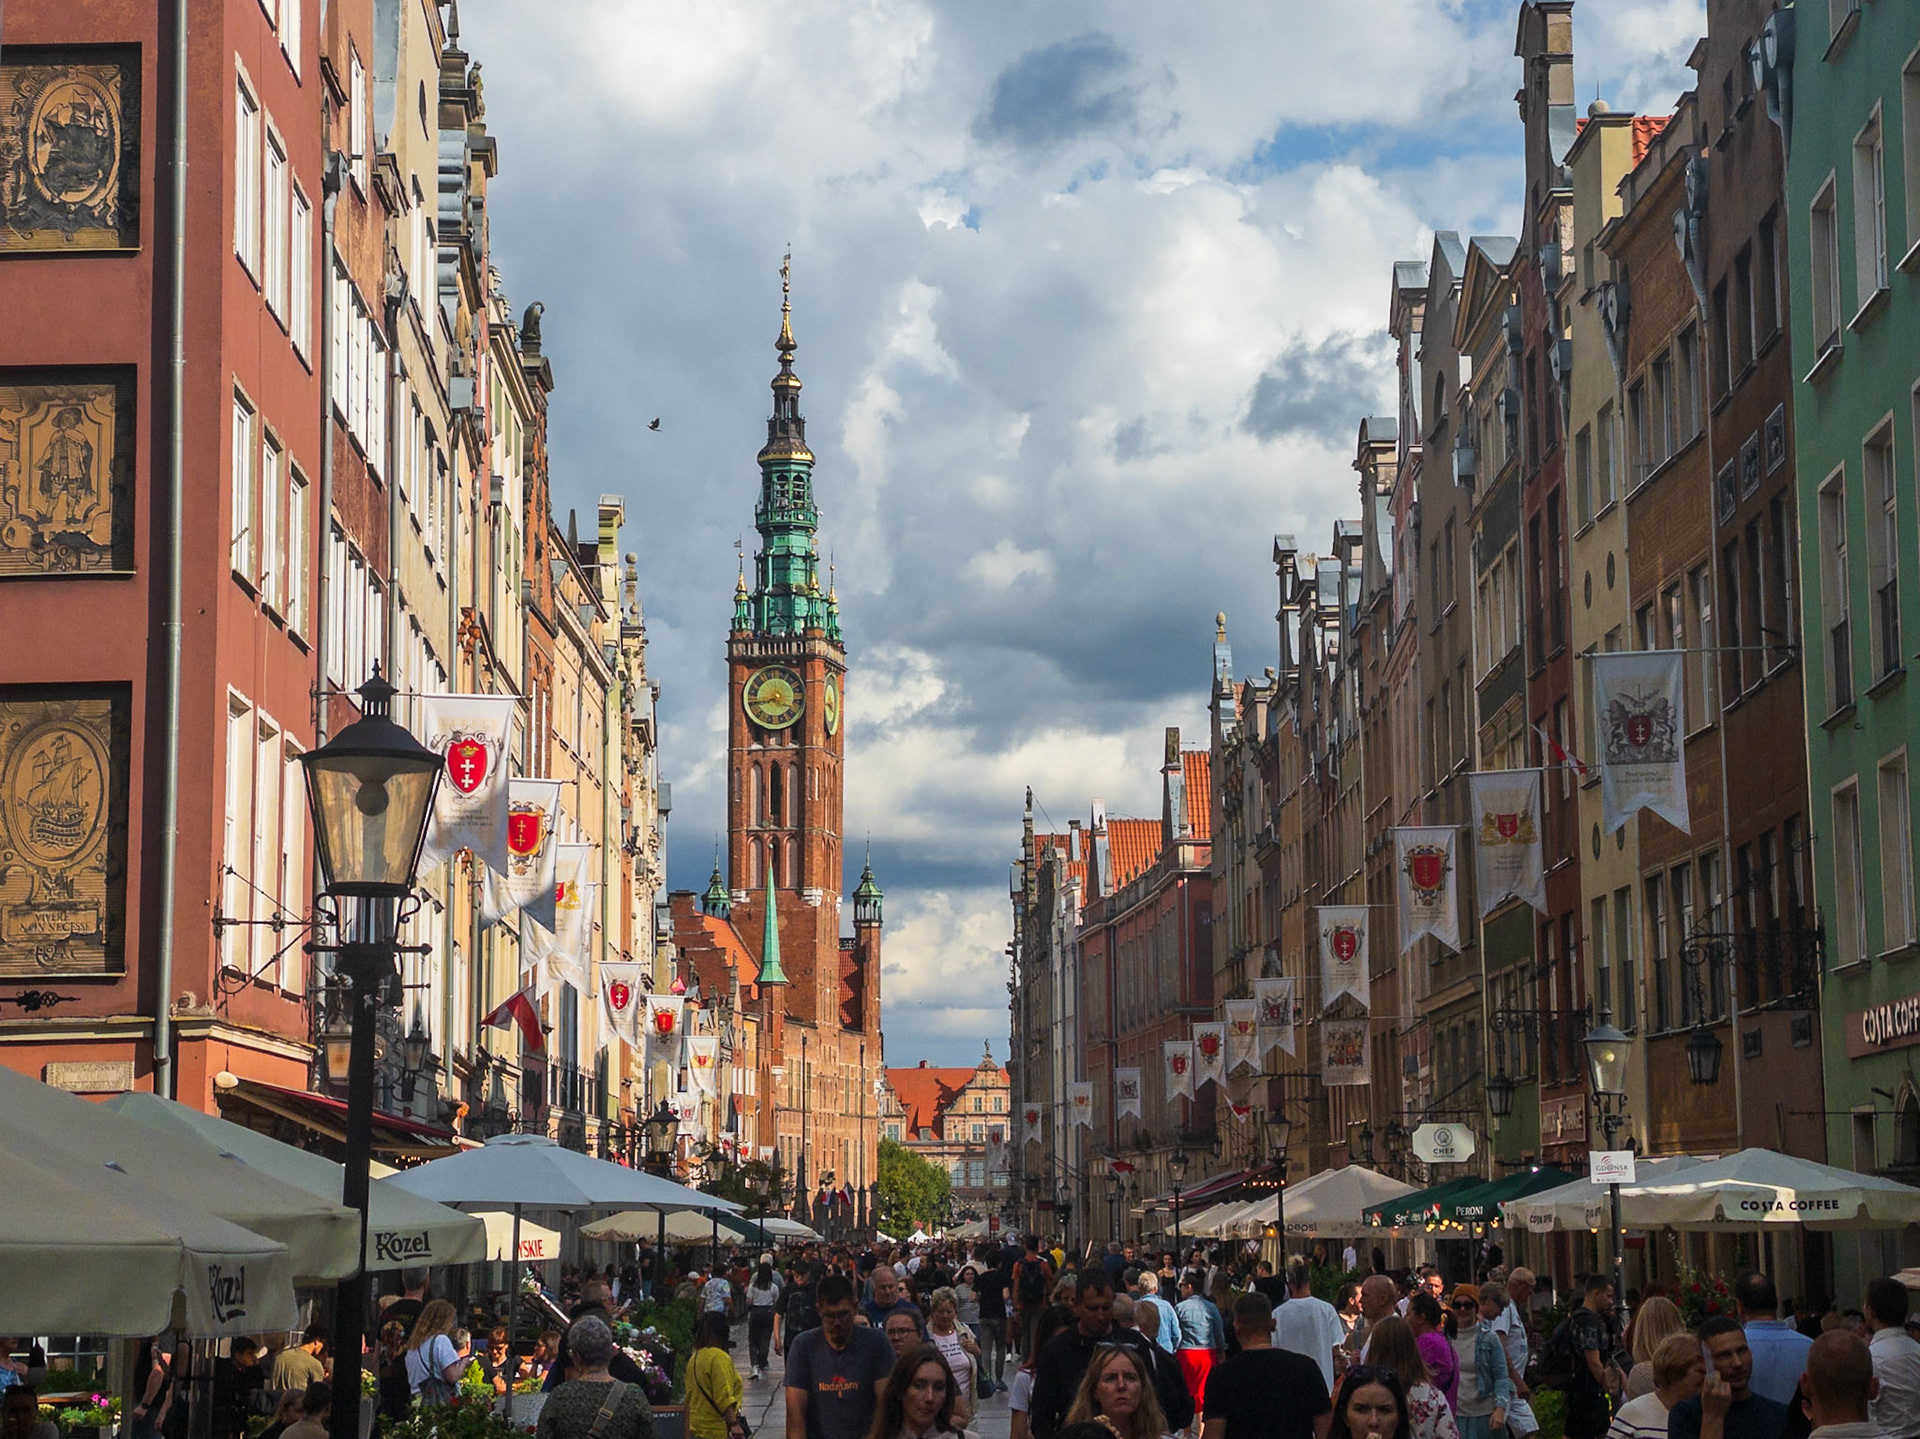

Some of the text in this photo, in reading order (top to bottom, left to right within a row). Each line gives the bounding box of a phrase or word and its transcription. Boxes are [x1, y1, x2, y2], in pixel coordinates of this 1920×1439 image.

[35, 911, 69, 922] VIVERE
[47, 921, 90, 933] NECESSE
[1862, 1004, 1894, 1045] COSTA
[1432, 1147, 1456, 1155] CHEF
[1455, 1205, 1484, 1216] PERONI
[1740, 1199, 1840, 1213] COSTA COFFEE
[1287, 1222, 1318, 1232] pepsi
[374, 1230, 432, 1262] Kozel
[518, 1239, 545, 1258] YSKIE
[208, 1263, 246, 1325] Kozel
